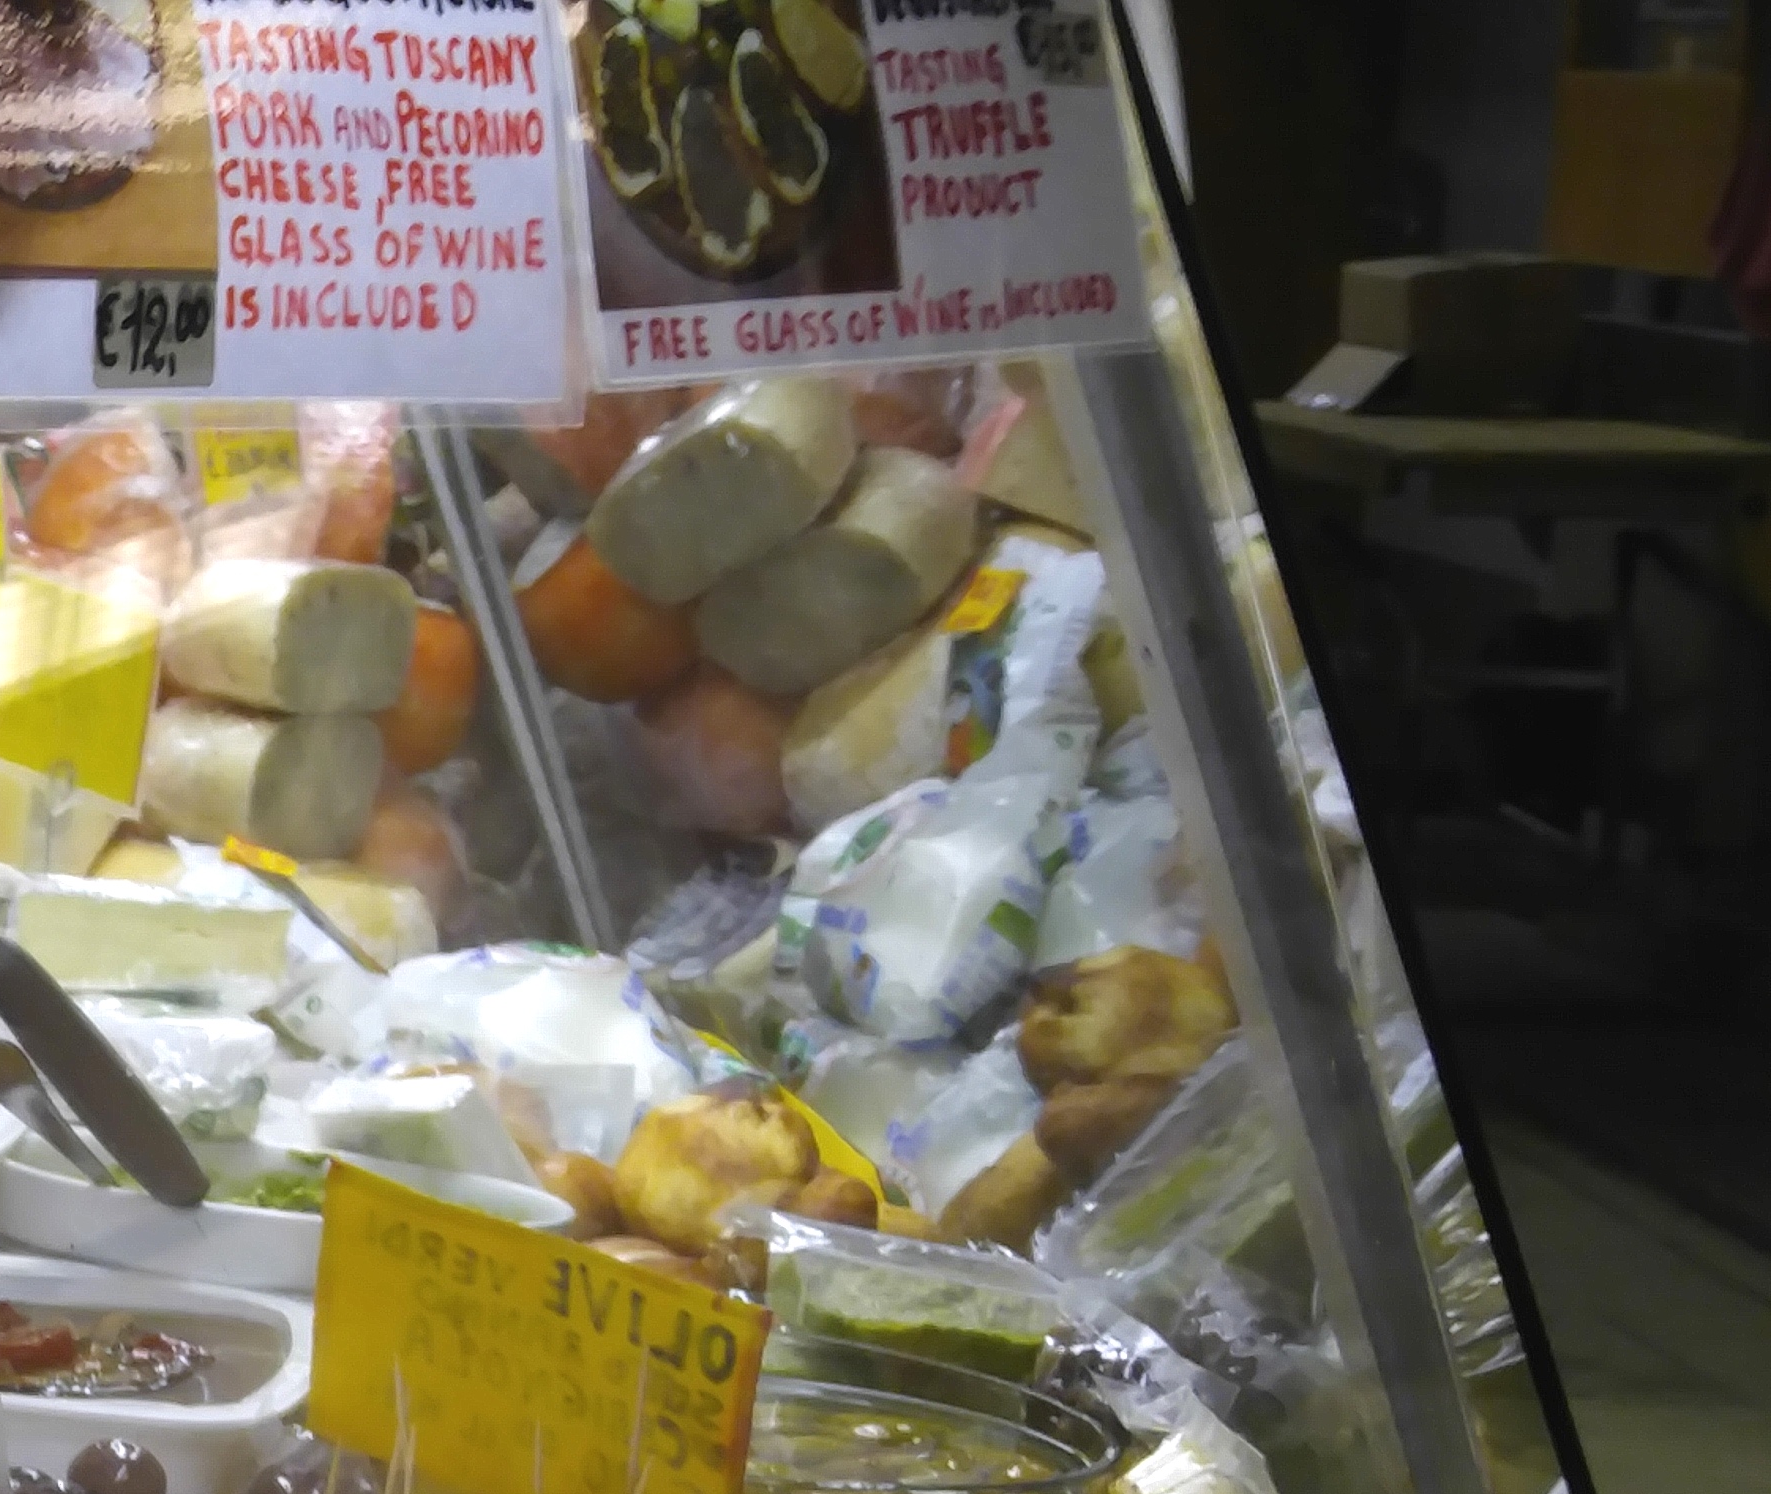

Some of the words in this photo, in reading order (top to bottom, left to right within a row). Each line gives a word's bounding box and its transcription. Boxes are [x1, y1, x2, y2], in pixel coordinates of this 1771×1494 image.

[197, 20, 371, 82] TASTING
[373, 30, 537, 93] TUSCANY
[875, 42, 1006, 94] TASTING
[212, 82, 322, 151] PORK
[334, 105, 394, 152] AND
[395, 89, 545, 158] PECORINO
[891, 91, 1052, 161] TRUFFLE
[902, 168, 1044, 224] PRODUCT
[228, 214, 354, 268] GLASS
[375, 222, 425, 270] OF
[433, 218, 547, 271] WINE
[224, 284, 259, 330] IS
[272, 279, 477, 332] INCLUDED
[623, 310, 712, 368] FREE
[734, 307, 839, 355] GLASS
[847, 304, 884, 343] OF
[893, 275, 971, 338] WINE
